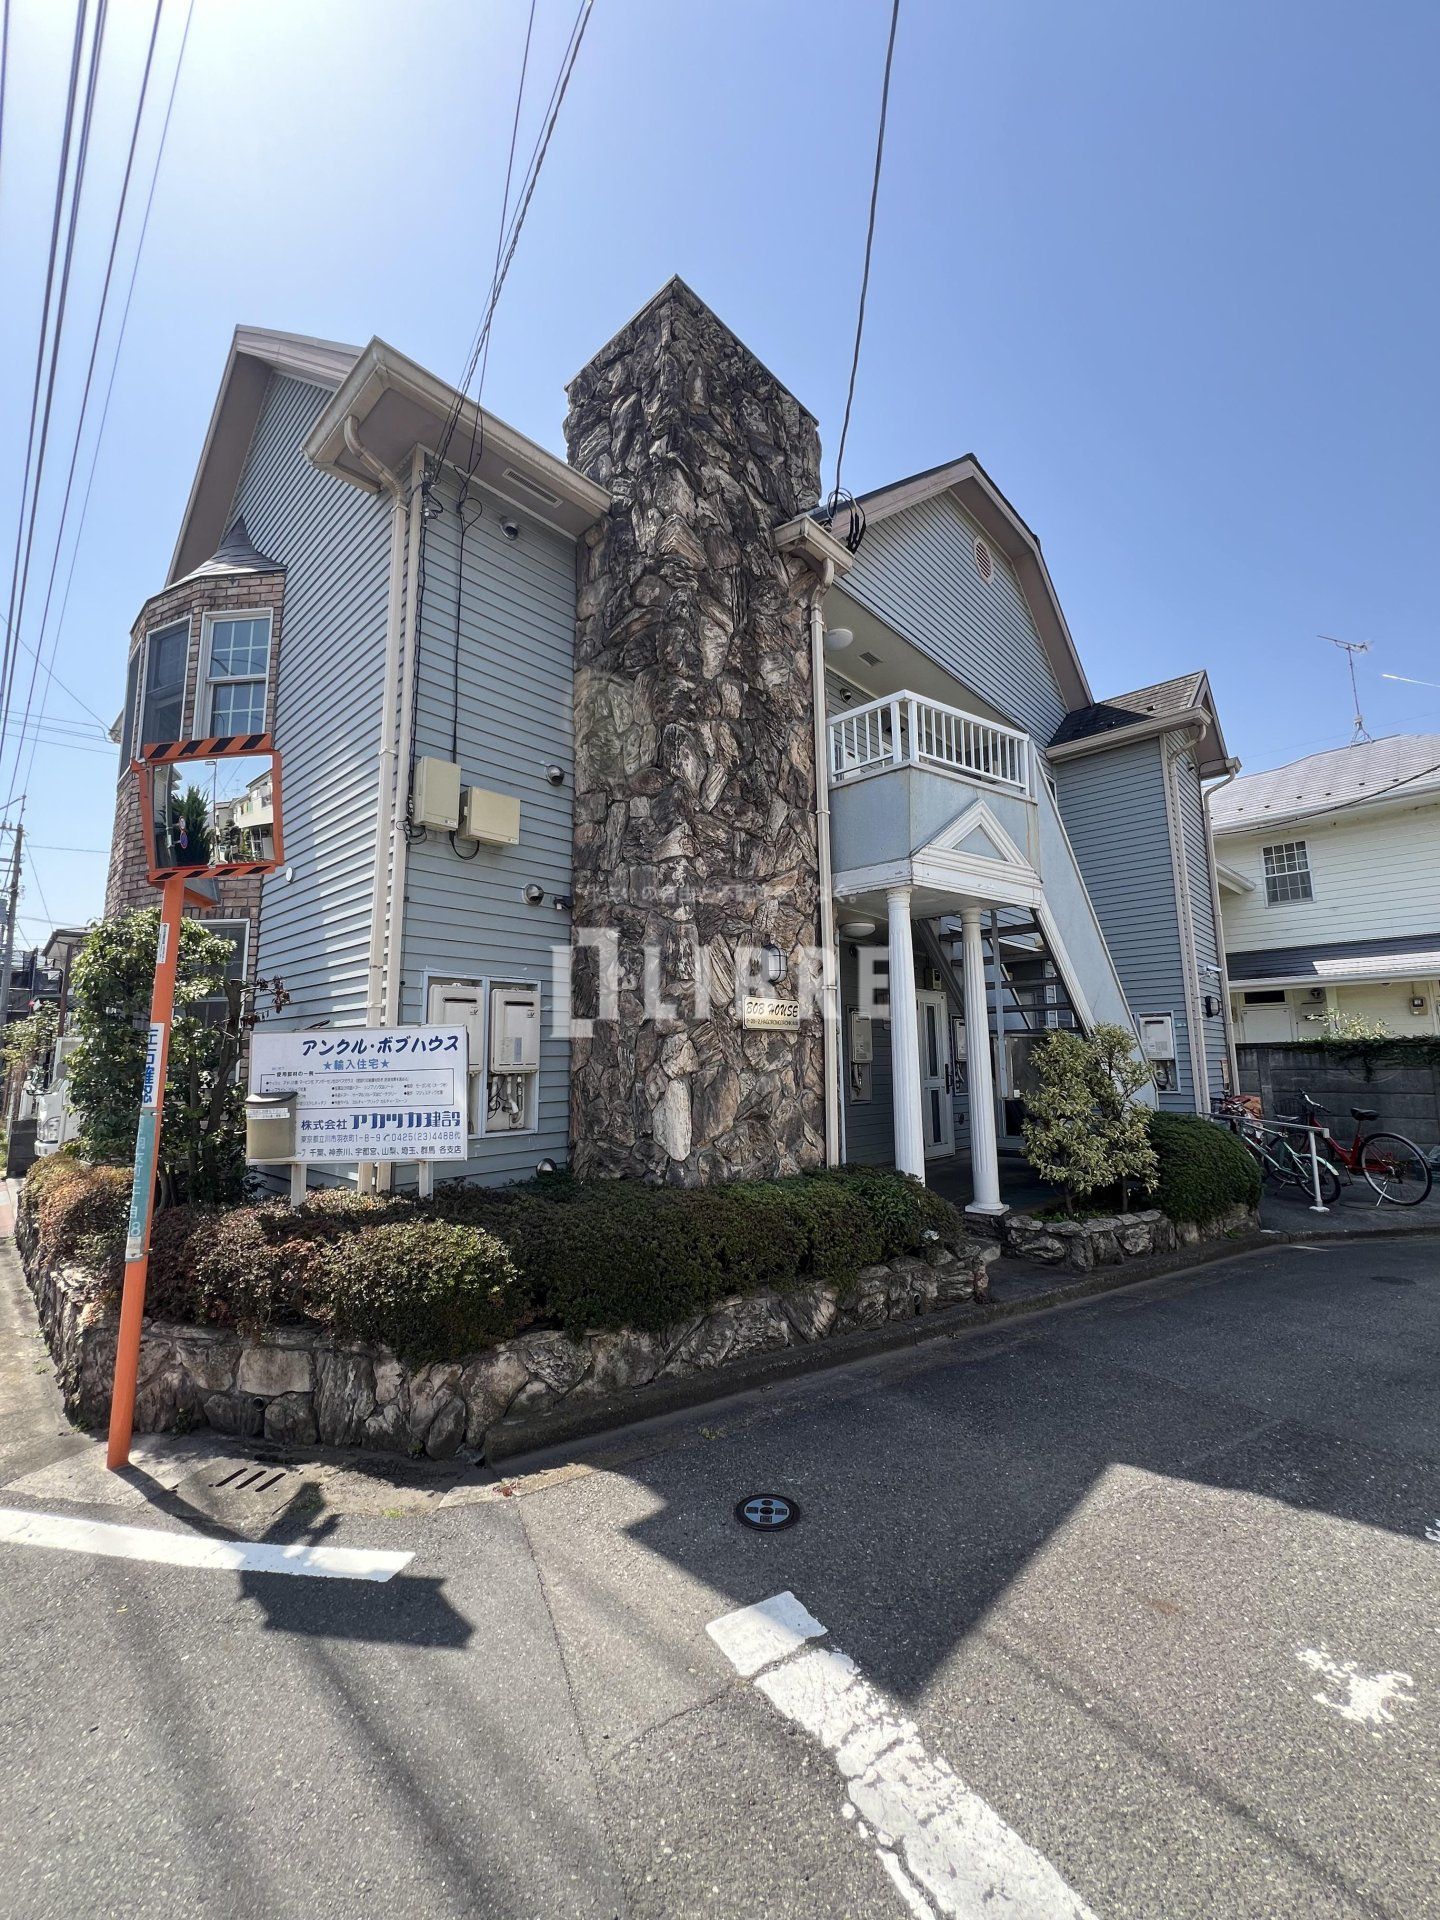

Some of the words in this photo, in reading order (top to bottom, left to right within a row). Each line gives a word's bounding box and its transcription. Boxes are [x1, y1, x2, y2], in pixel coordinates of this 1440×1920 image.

[746, 1001, 765, 1015] BOB
[767, 1003, 799, 1018] HOUSE
[302, 1035, 459, 1056] アンクル・ボブハウス
[301, 1119, 348, 1130] 株式会社
